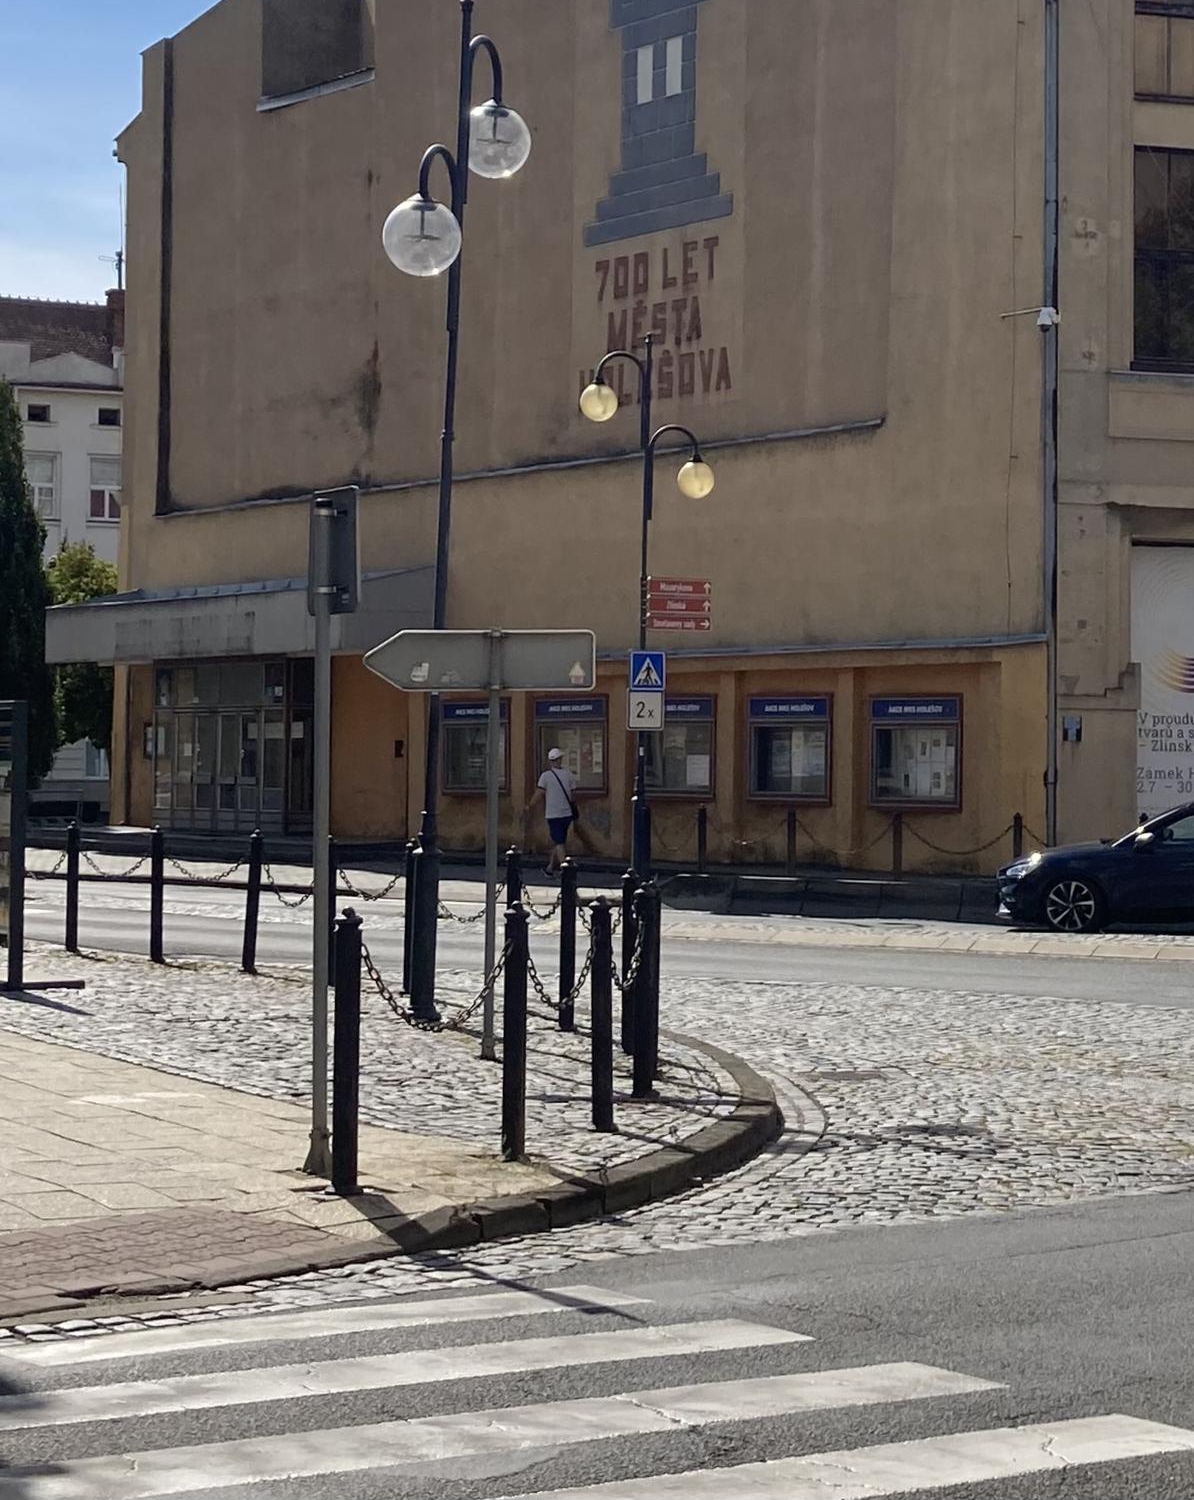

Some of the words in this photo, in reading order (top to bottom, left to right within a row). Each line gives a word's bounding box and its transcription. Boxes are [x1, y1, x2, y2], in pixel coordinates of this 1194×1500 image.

[595, 251, 649, 302] 700
[662, 236, 719, 289] LET
[607, 296, 701, 353] MĚSTA
[1138, 712, 1148, 724] V
[1138, 726, 1172, 739] tvarů
[1177, 731, 1184, 739] a
[1136, 766, 1184, 779] Zámek
